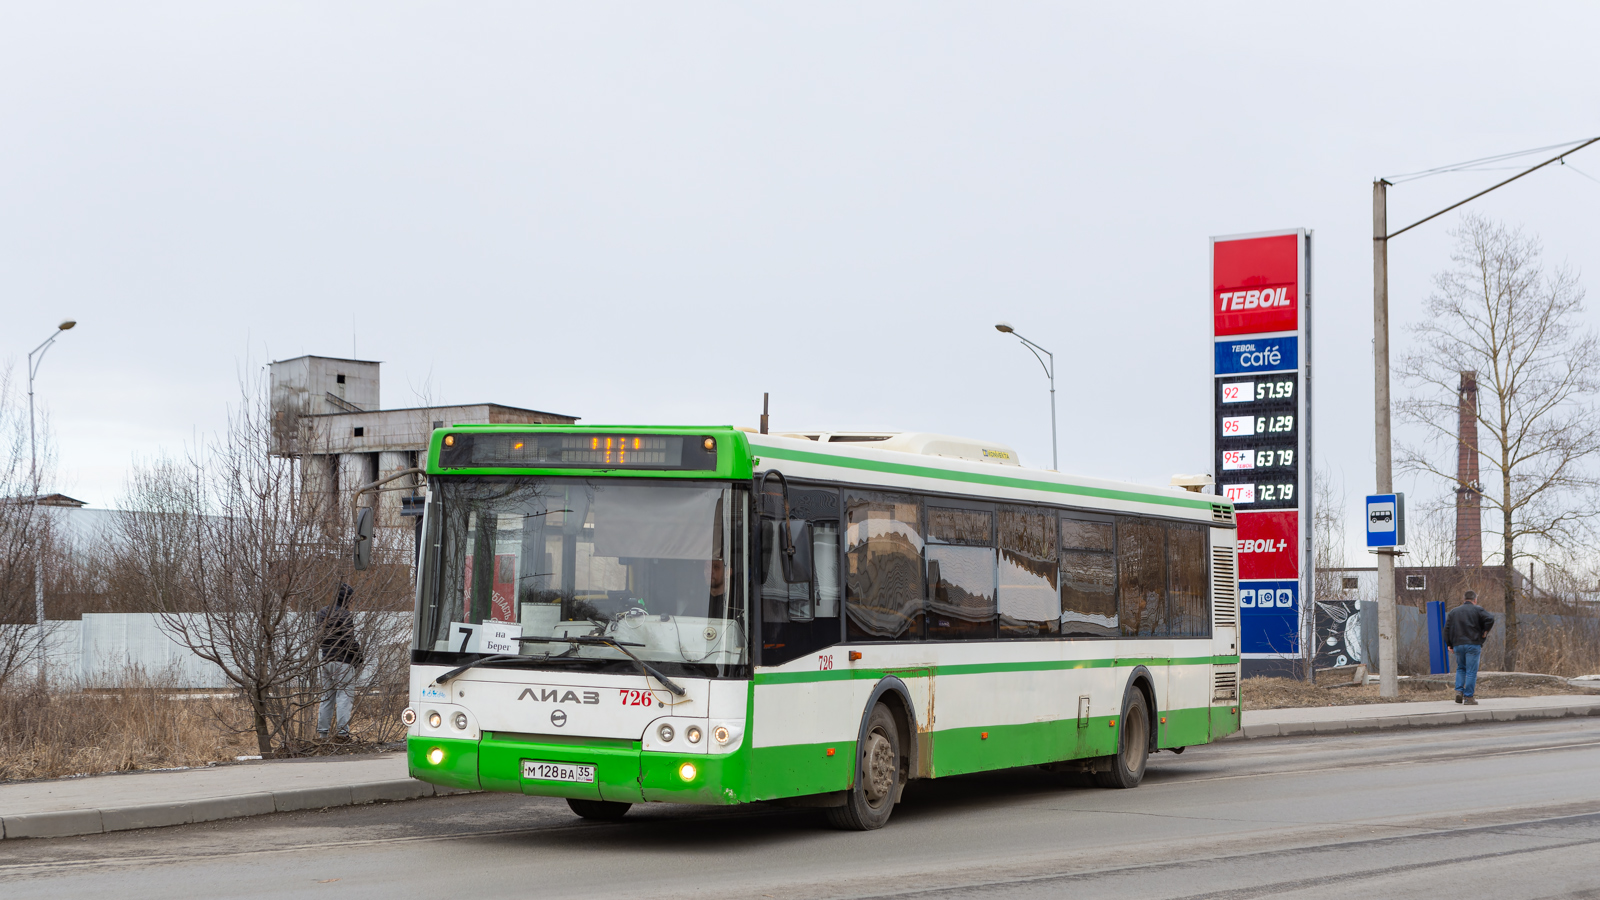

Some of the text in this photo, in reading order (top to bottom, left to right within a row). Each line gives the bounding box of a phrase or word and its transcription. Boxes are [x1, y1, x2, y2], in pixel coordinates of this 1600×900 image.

[1220, 287, 1290, 311] TEBOIL
[1232, 344, 1256, 353] TEBOIL
[1240, 345, 1282, 367] café
[1224, 381, 1293, 399] 92 57.59
[1224, 415, 1293, 433] 95 61.29
[1224, 451, 1246, 464] 95+
[1226, 483, 1293, 502] ДТ 72.79
[1237, 538, 1288, 553] EBOIL+
[458, 627, 473, 653] 7
[487, 641, 511, 652] Берег
[818, 654, 833, 671] 726
[517, 688, 600, 705] ЛИАЗ
[619, 689, 652, 707] 726
